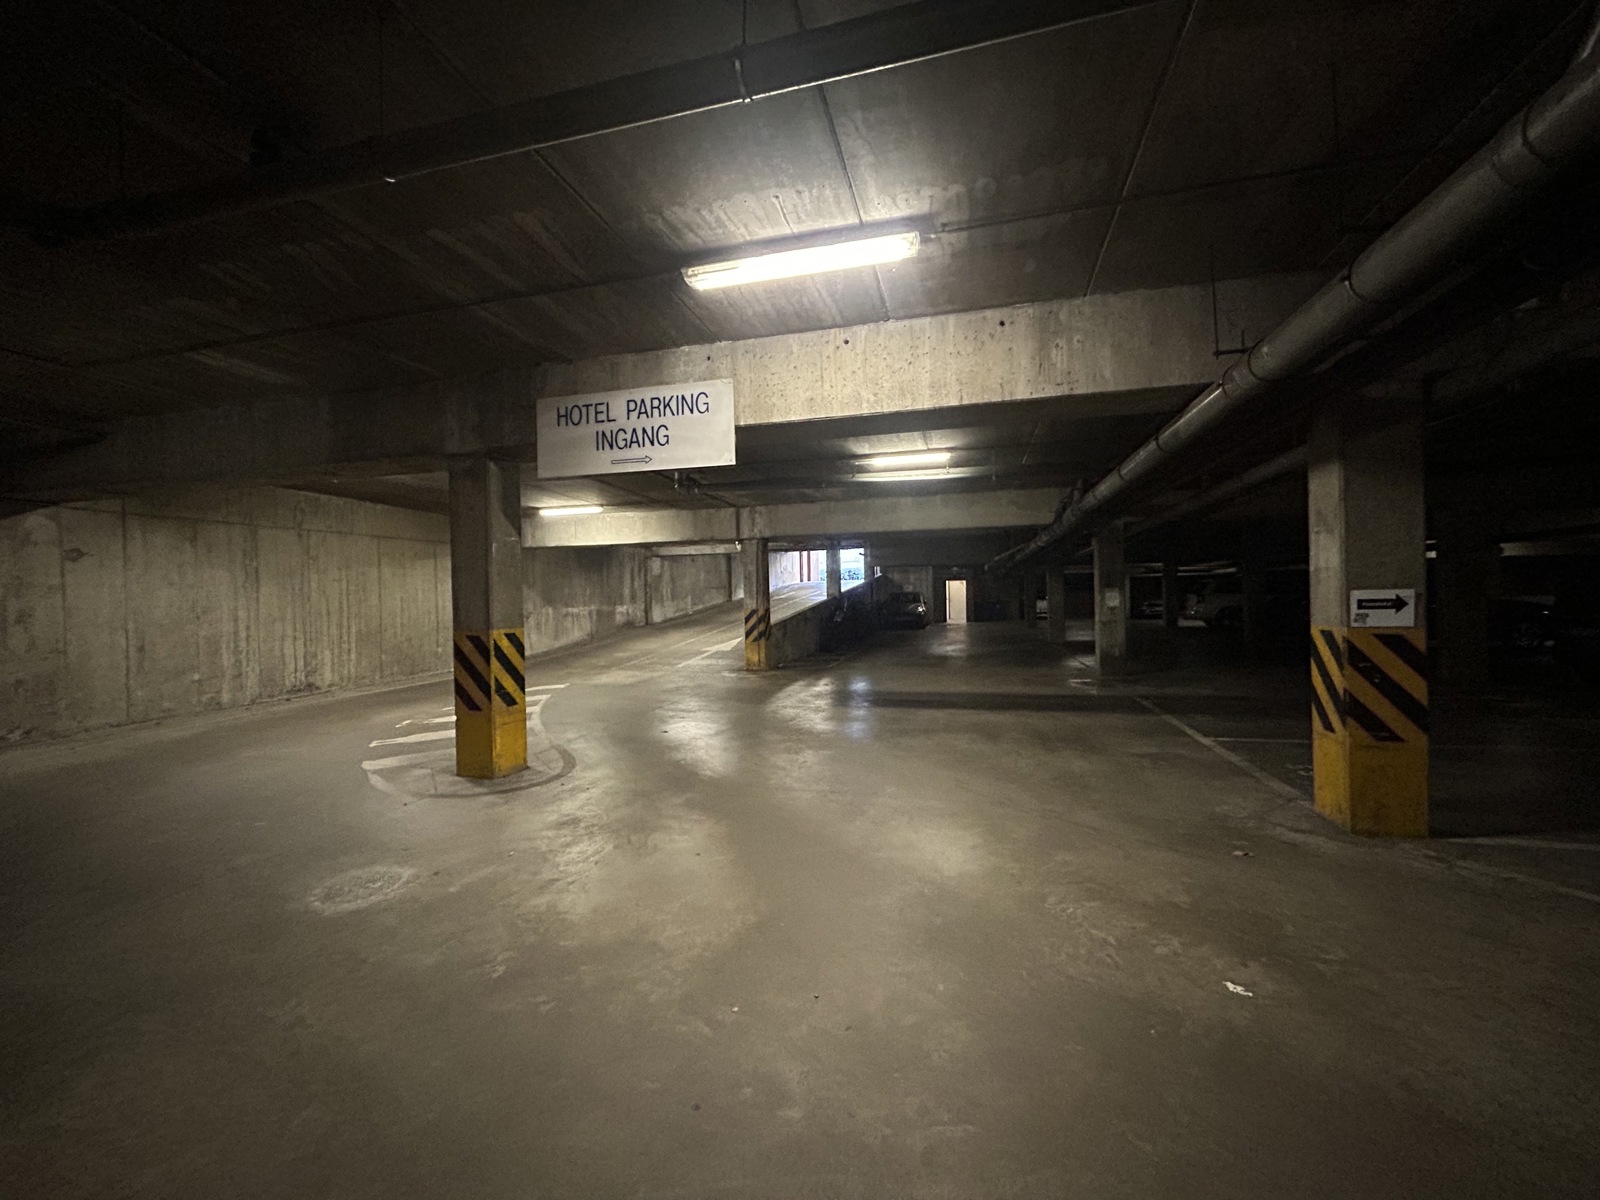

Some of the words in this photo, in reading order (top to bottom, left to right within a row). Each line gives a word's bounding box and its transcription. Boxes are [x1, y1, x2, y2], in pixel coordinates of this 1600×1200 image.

[556, 402, 616, 427] HOTEL
[626, 391, 709, 420] PARKING
[596, 424, 670, 451] INGANG
